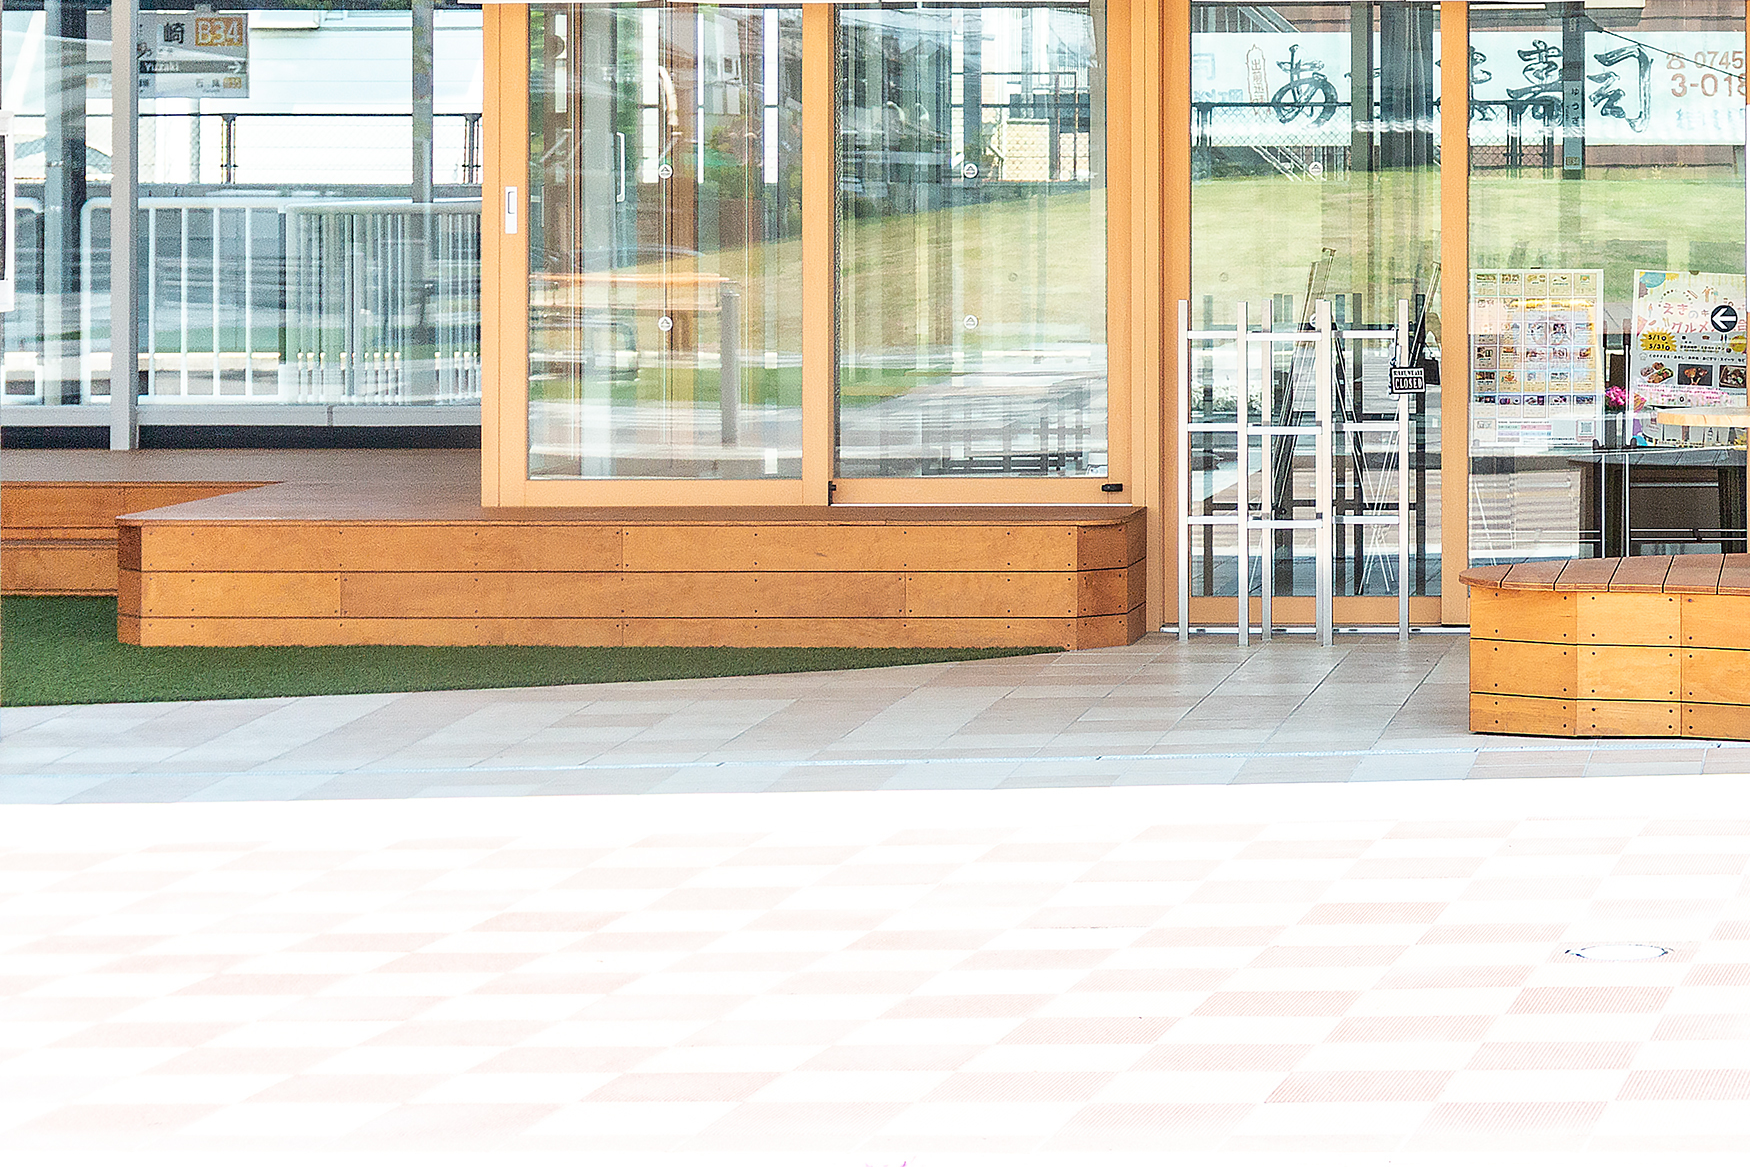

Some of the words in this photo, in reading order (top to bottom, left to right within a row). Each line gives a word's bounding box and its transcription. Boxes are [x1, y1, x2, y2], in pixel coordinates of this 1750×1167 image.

[198, 20, 240, 43] B34
[1694, 51, 1744, 70] 0745
[1395, 377, 1422, 389] CLOSED
